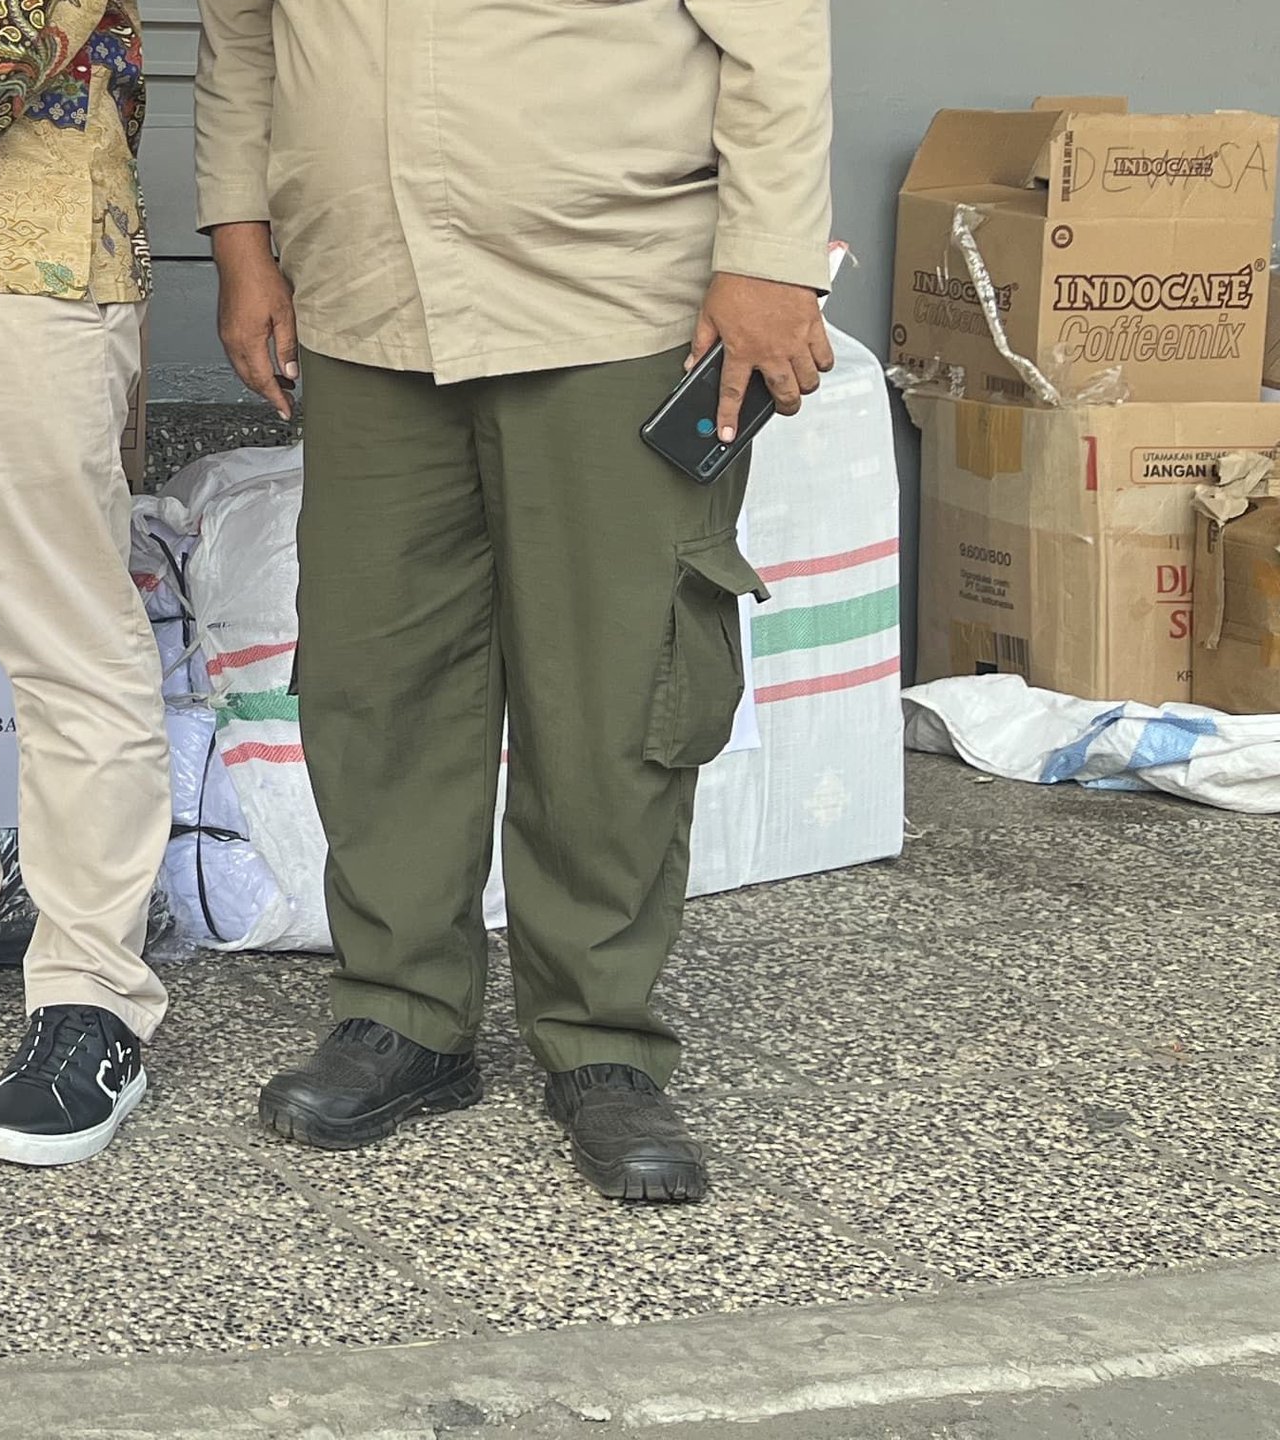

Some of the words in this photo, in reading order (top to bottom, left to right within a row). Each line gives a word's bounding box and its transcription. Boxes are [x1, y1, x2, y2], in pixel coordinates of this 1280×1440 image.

[913, 270, 1012, 312] INDOCÉ
[1053, 264, 1253, 311] INDOCAFÉ
[1059, 313, 1246, 363] Coffeemix
[1143, 464, 1207, 478] JANGAN
